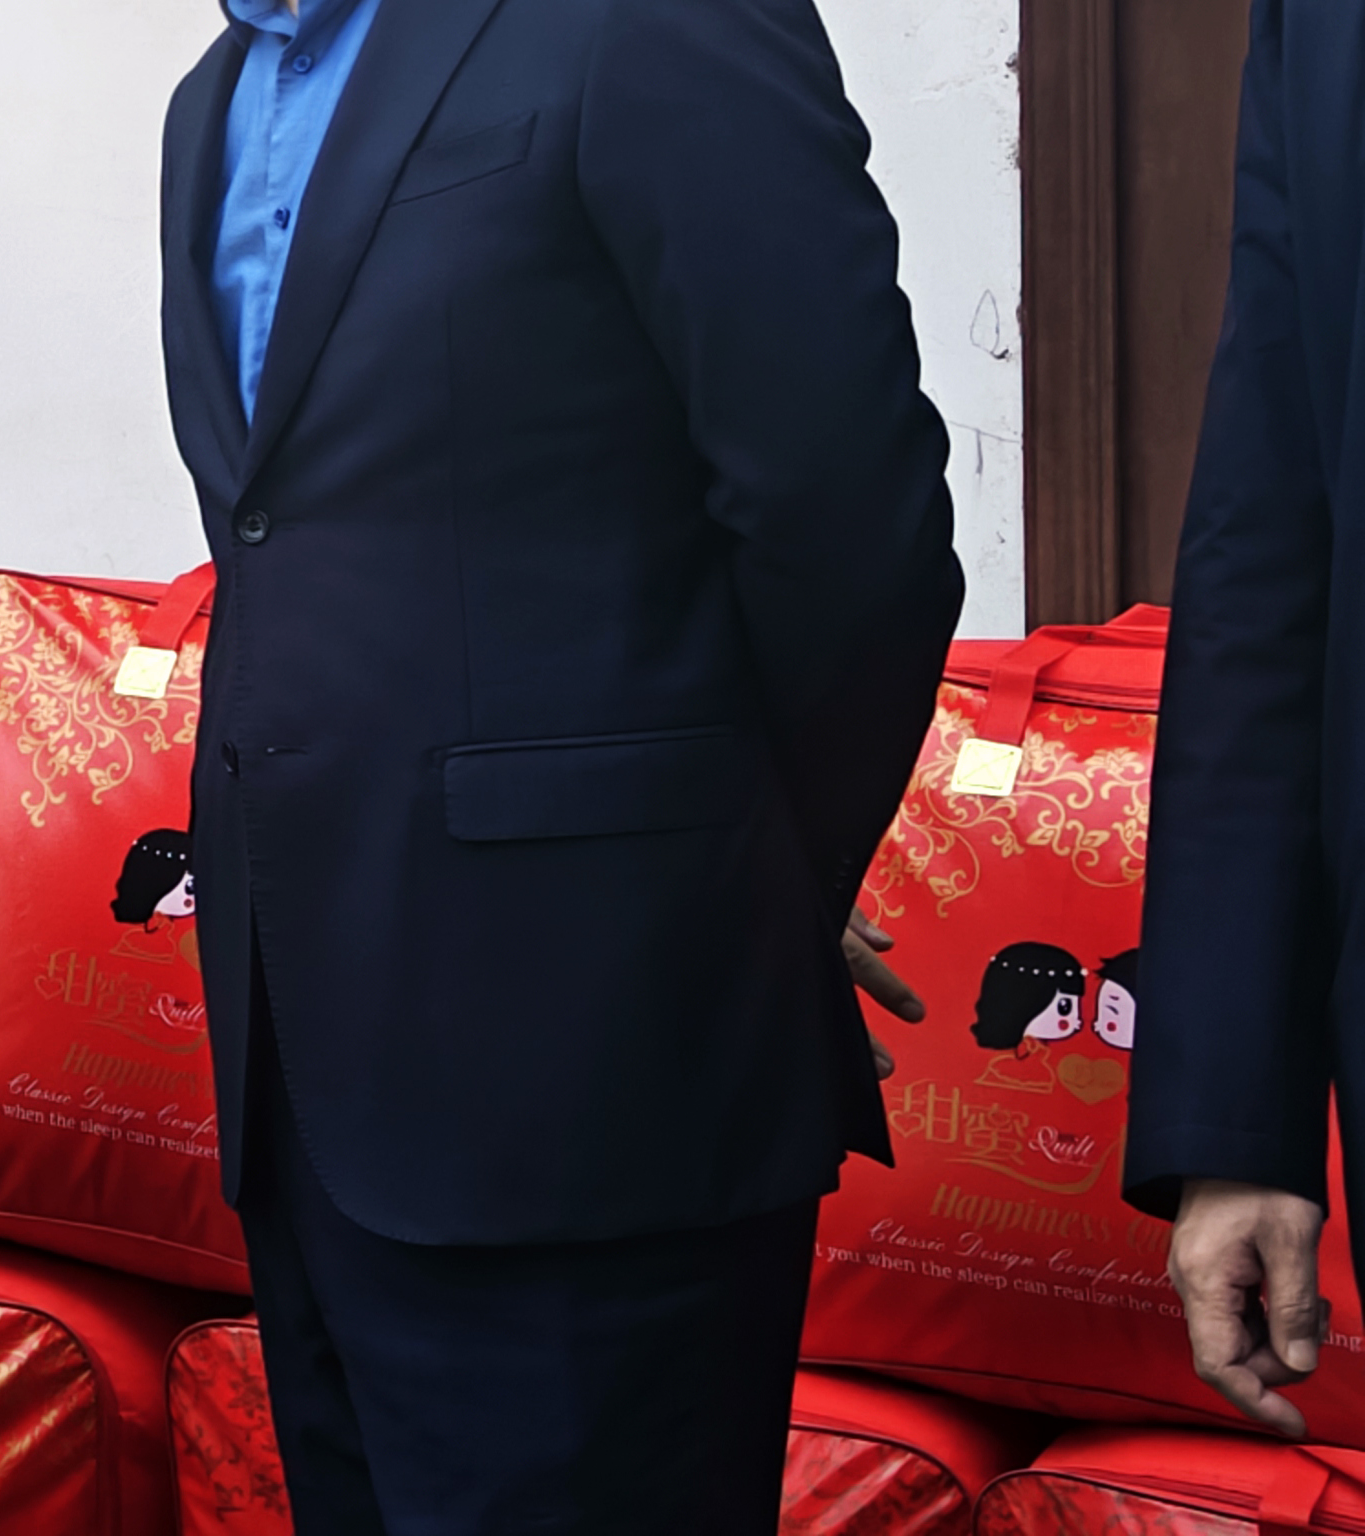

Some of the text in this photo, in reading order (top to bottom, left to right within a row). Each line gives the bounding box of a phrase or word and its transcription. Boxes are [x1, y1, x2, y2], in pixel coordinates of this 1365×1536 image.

[2, 1101, 46, 1124] when
[49, 1111, 75, 1131] the
[80, 1117, 123, 1141] sleep
[125, 1128, 156, 1147] can
[8, 1072, 218, 1140] Classic Design Comfo
[1027, 1125, 1098, 1167] Quilt
[928, 1182, 1112, 1244] Happiness
[826, 1245, 862, 1264] you
[866, 1250, 918, 1274] when
[921, 1261, 953, 1280] the
[957, 1267, 1009, 1291] sleep
[1012, 1277, 1049, 1297] can
[869, 1217, 946, 1252] Classic
[953, 1231, 1036, 1272] Design
[1047, 1248, 1175, 1289] Comfortab
